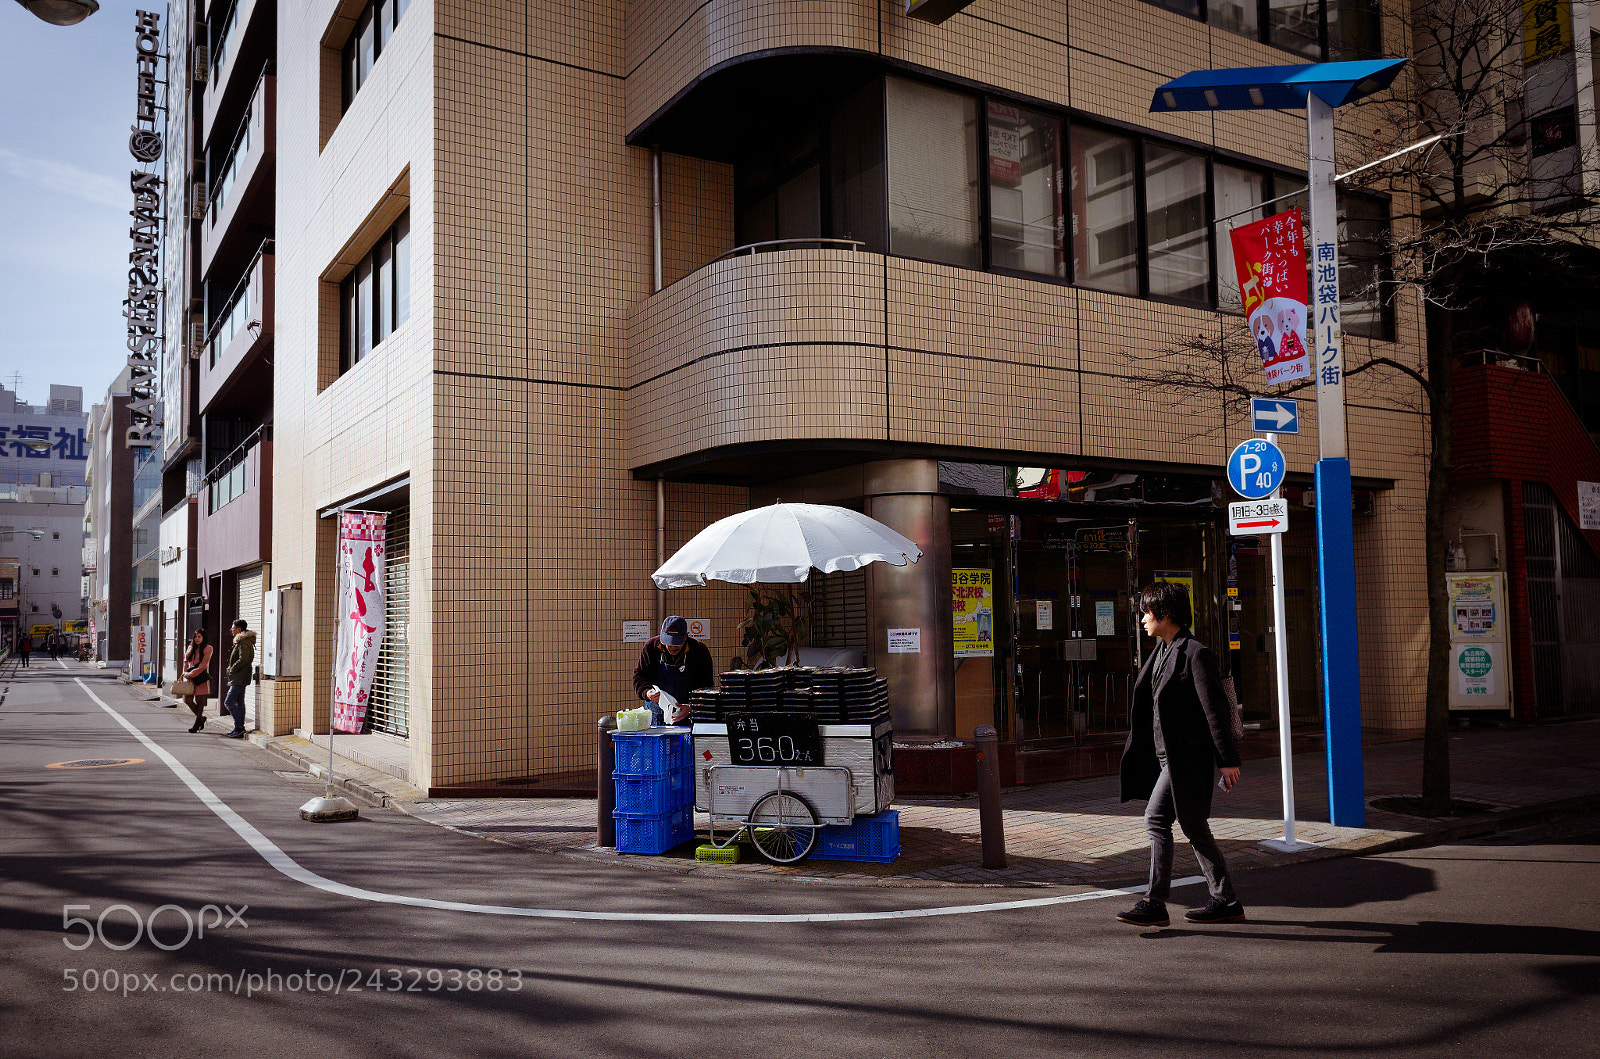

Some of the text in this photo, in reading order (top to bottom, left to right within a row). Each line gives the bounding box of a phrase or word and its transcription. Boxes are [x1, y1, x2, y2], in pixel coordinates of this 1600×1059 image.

[135, 9, 160, 122] HOTEL
[1260, 224, 1275, 277] パーク街
[1285, 216, 1299, 257] 今年も
[1317, 242, 1340, 386] 南池袋パーク街
[1243, 442, 1267, 453] 7-20
[1240, 453, 1261, 490] P
[1256, 472, 1272, 488] 40
[736, 717, 759, 731] 弁当
